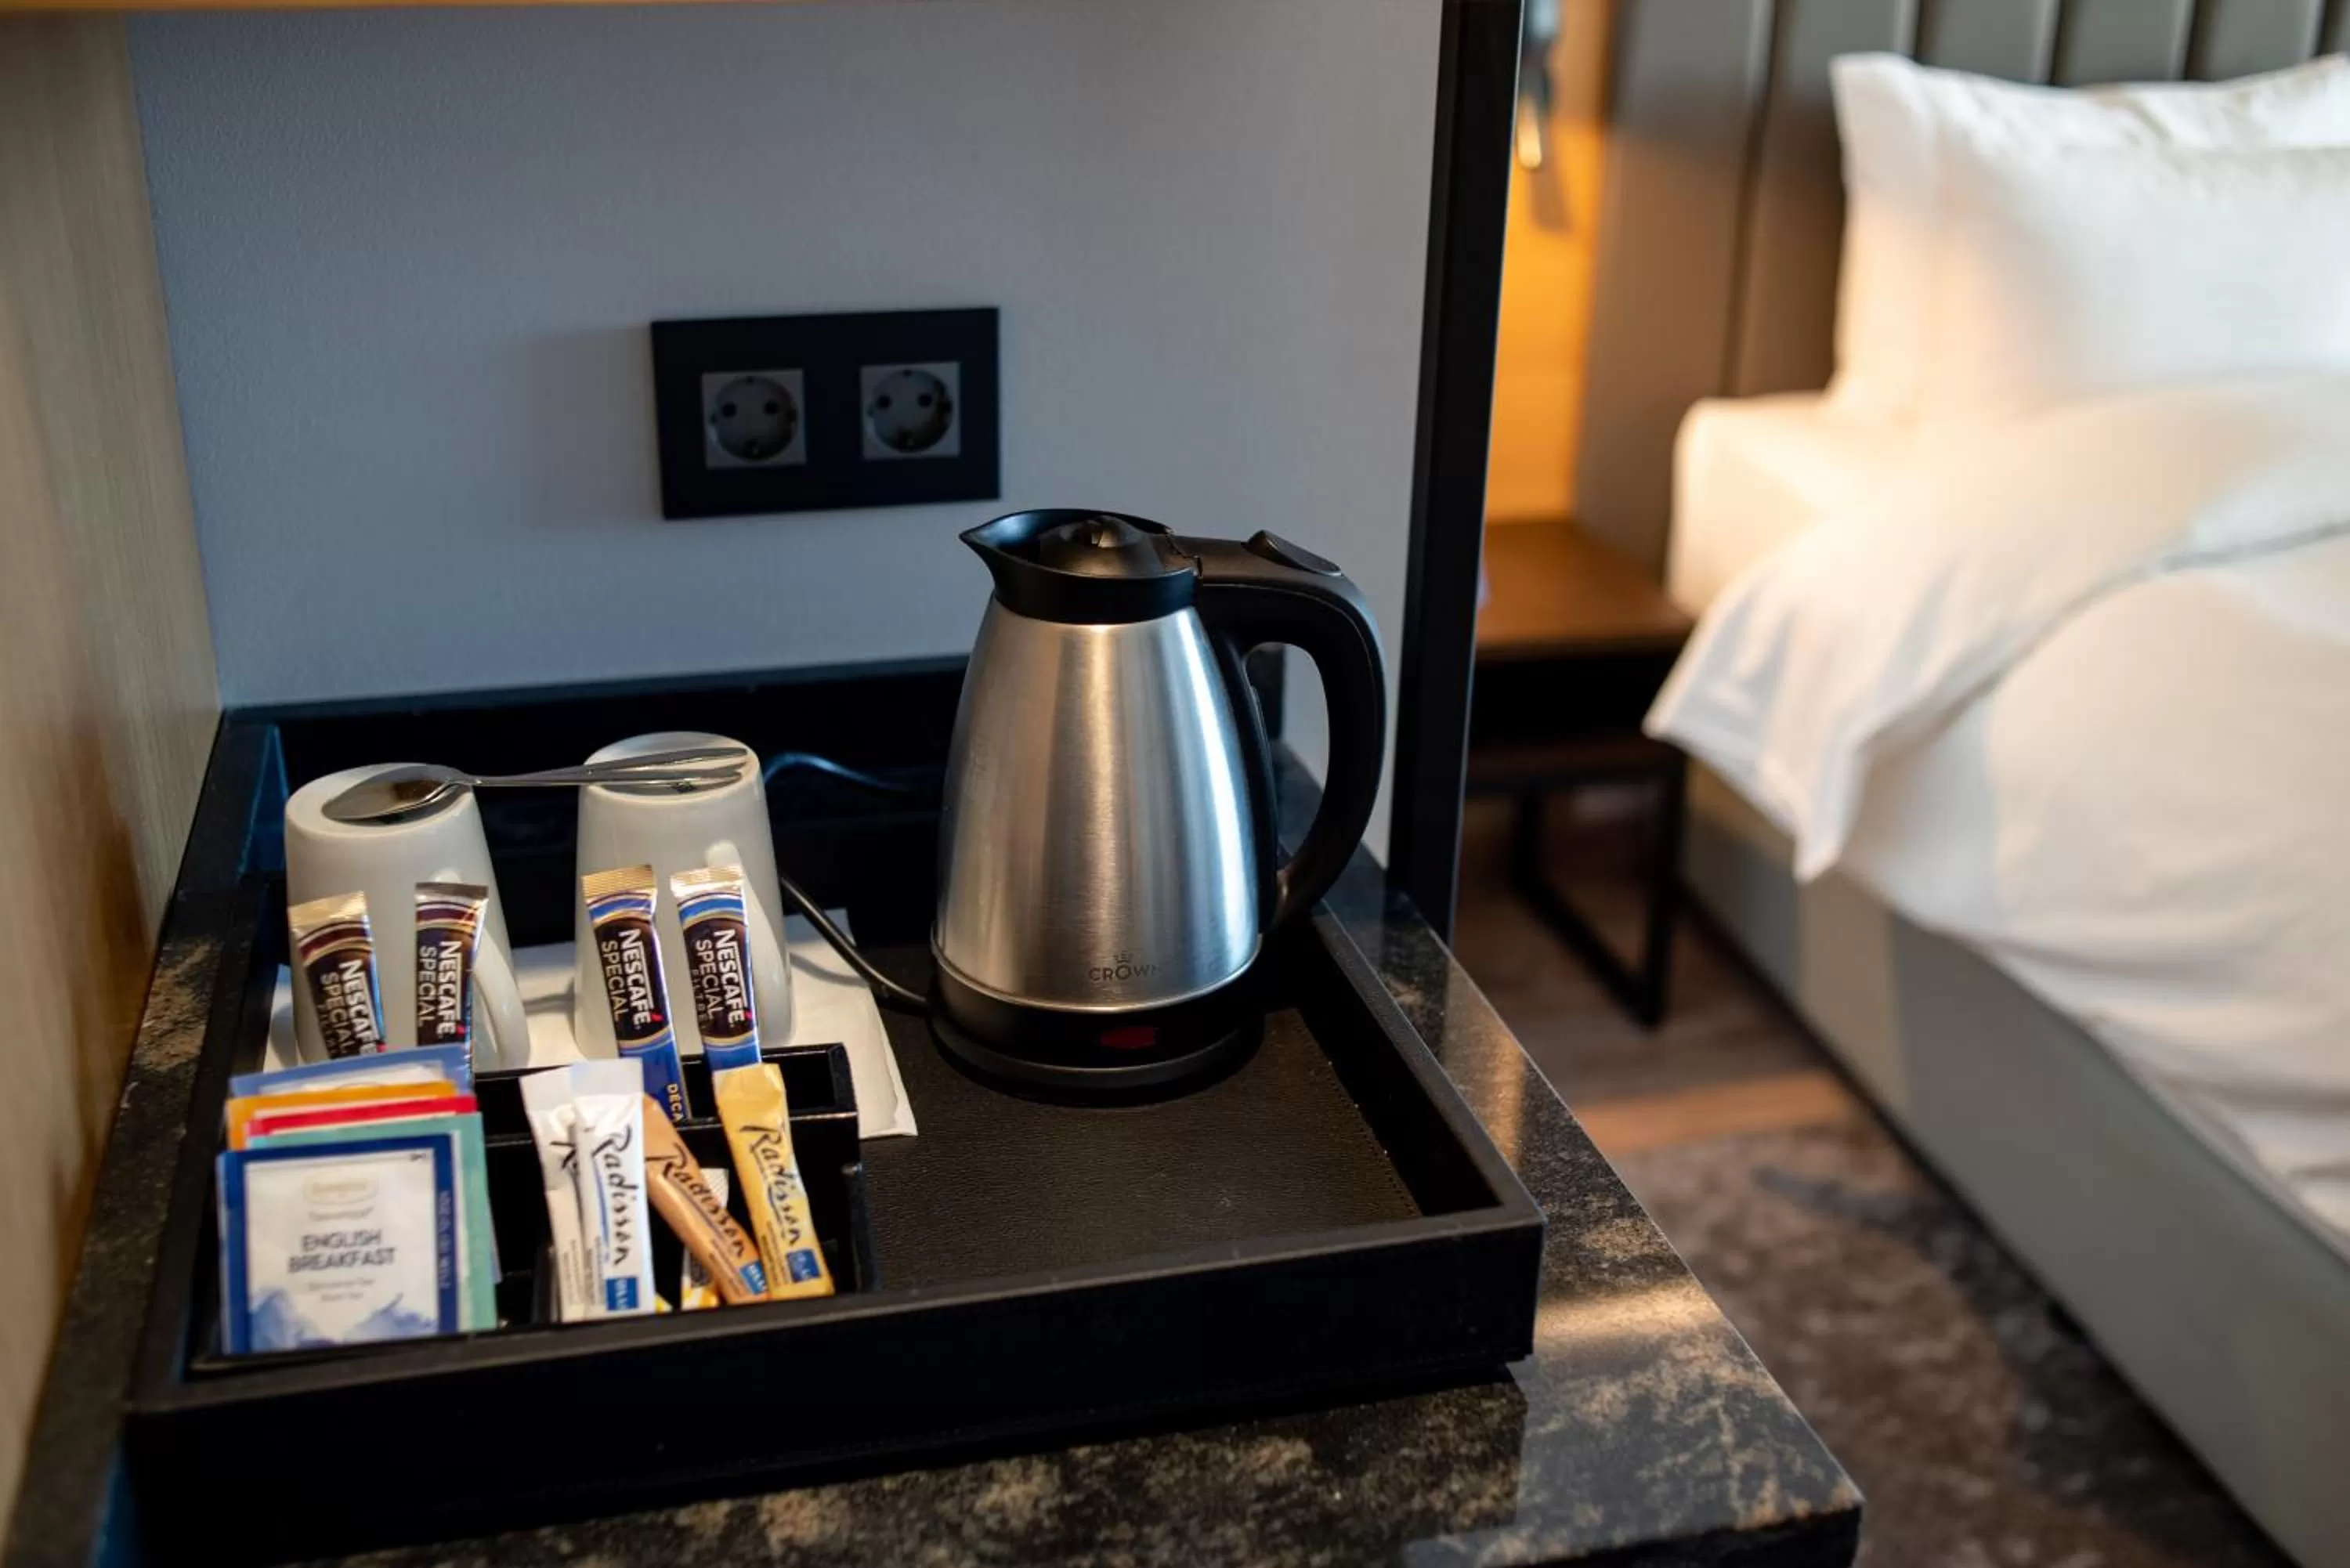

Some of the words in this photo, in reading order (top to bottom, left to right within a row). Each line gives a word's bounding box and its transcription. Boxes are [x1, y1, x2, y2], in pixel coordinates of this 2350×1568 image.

[320, 972, 348, 1054] SPECIAL
[418, 946, 437, 1026] SPECIAL
[601, 941, 629, 1021] SPECIAL
[696, 939, 722, 1020] SPECIAL
[591, 1125, 638, 1266] Radisson
[645, 1143, 746, 1258] Radisson
[739, 1123, 801, 1247] Radisson
[287, 1247, 397, 1274] BREAKFAST
[301, 1229, 382, 1251] ENGLISH
